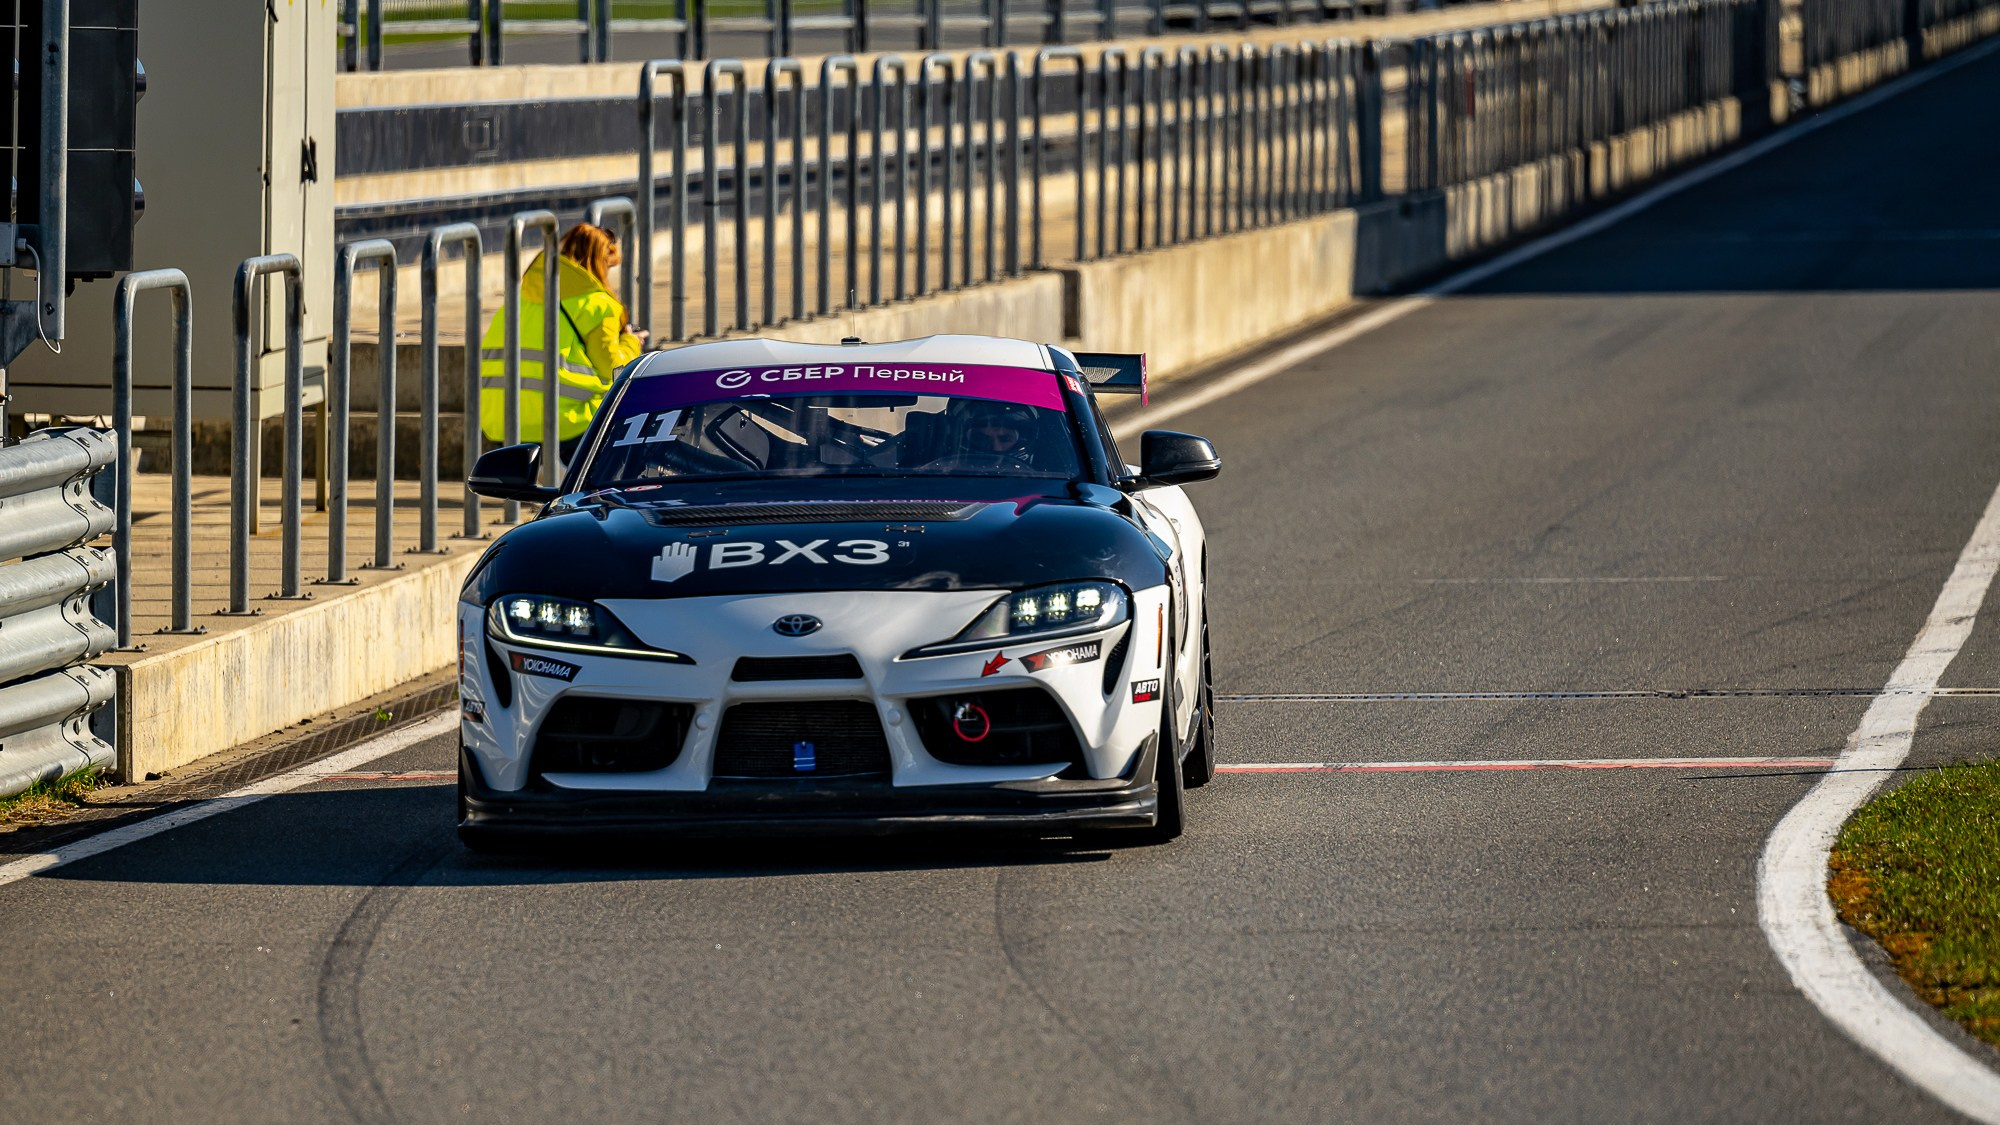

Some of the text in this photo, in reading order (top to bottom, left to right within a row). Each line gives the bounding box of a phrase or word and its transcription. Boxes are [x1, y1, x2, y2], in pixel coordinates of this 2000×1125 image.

[760, 366, 965, 384] СБЕР Первый
[612, 409, 682, 448] 11
[708, 539, 891, 570] BX3
[523, 657, 572, 678] YOKOHAMA
[1134, 680, 1159, 695] АВТО
